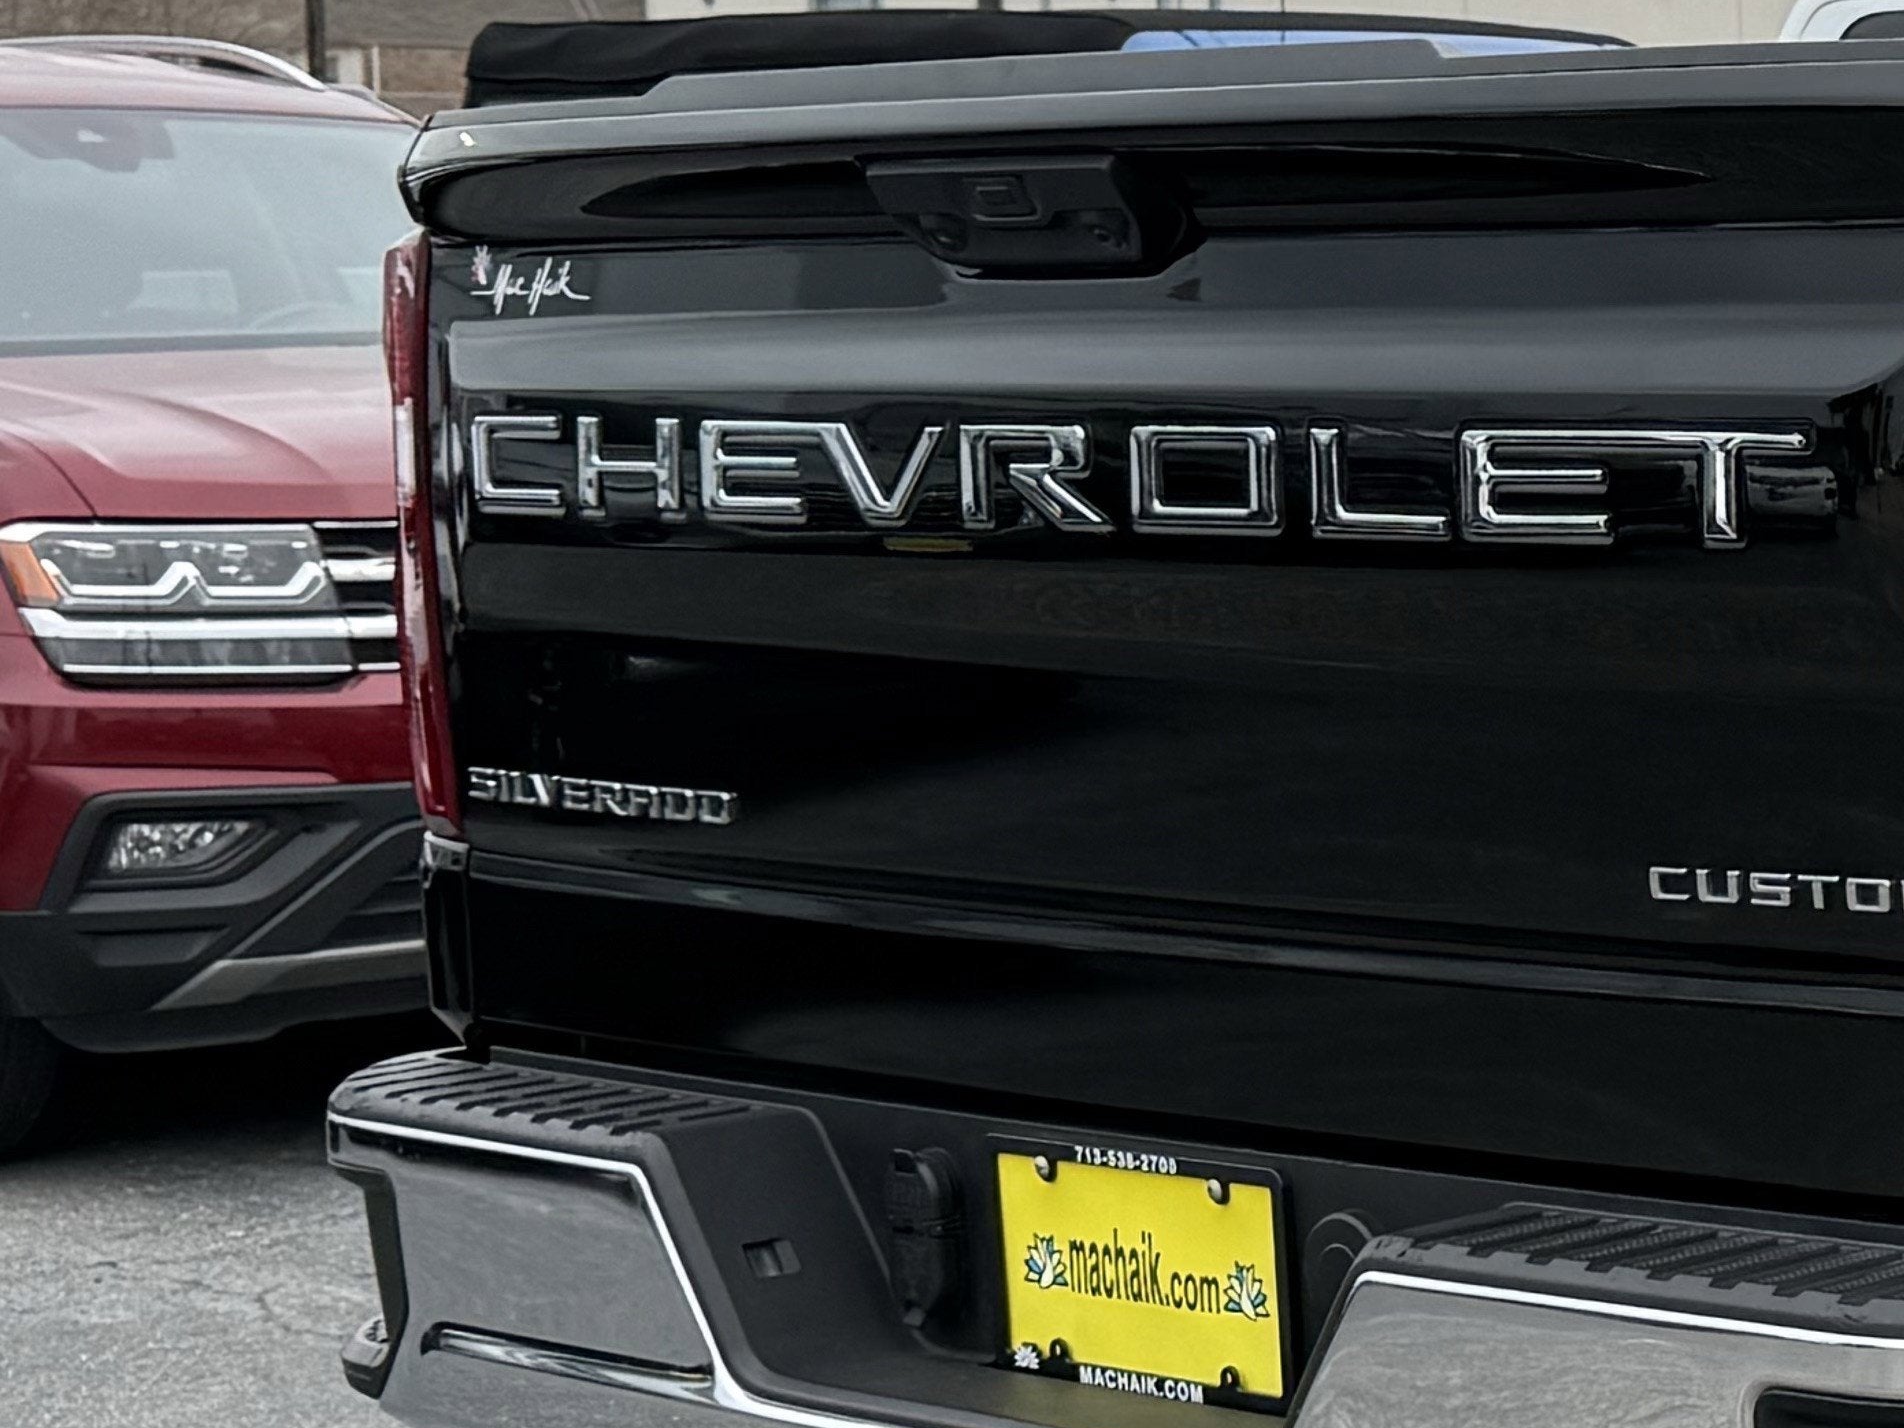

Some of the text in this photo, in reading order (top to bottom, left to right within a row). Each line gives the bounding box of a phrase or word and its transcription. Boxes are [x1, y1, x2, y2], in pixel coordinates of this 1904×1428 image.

[472, 413, 1813, 549] CHEVROLET
[467, 766, 737, 824] SILVERADO
[1068, 1228, 1221, 1314] machaik.com
[1079, 1366, 1204, 1404] MACHAIK.COM
